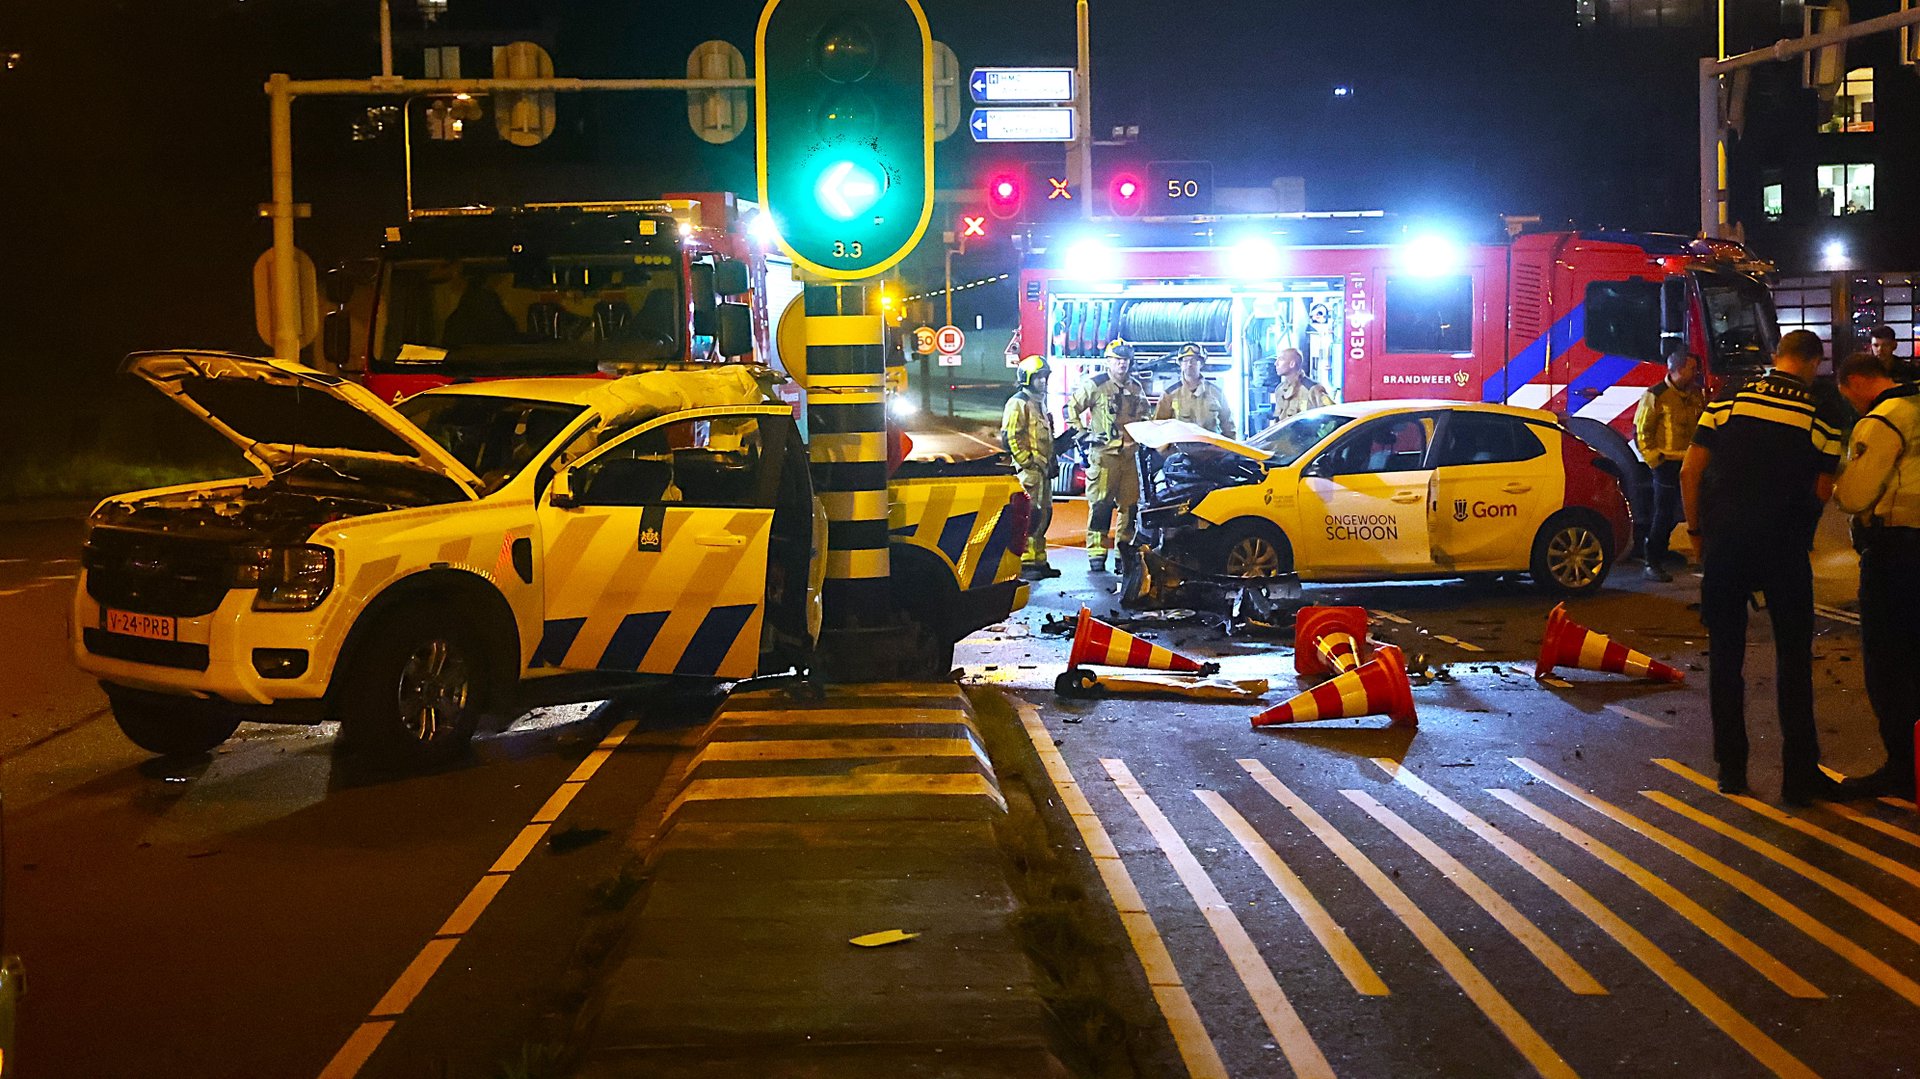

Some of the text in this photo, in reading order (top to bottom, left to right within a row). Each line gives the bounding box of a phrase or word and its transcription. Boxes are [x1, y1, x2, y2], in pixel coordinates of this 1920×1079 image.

[1167, 180, 1198, 198] 50
[832, 241, 863, 258] 3.3
[946, 356, 953, 364] C
[1383, 375, 1451, 384] BRANDWEER
[1472, 501, 1517, 518] Gom
[1324, 515, 1397, 526] ONGEWOON
[1326, 526, 1398, 541] SCHOON
[110, 612, 170, 637] V-24-PRB
